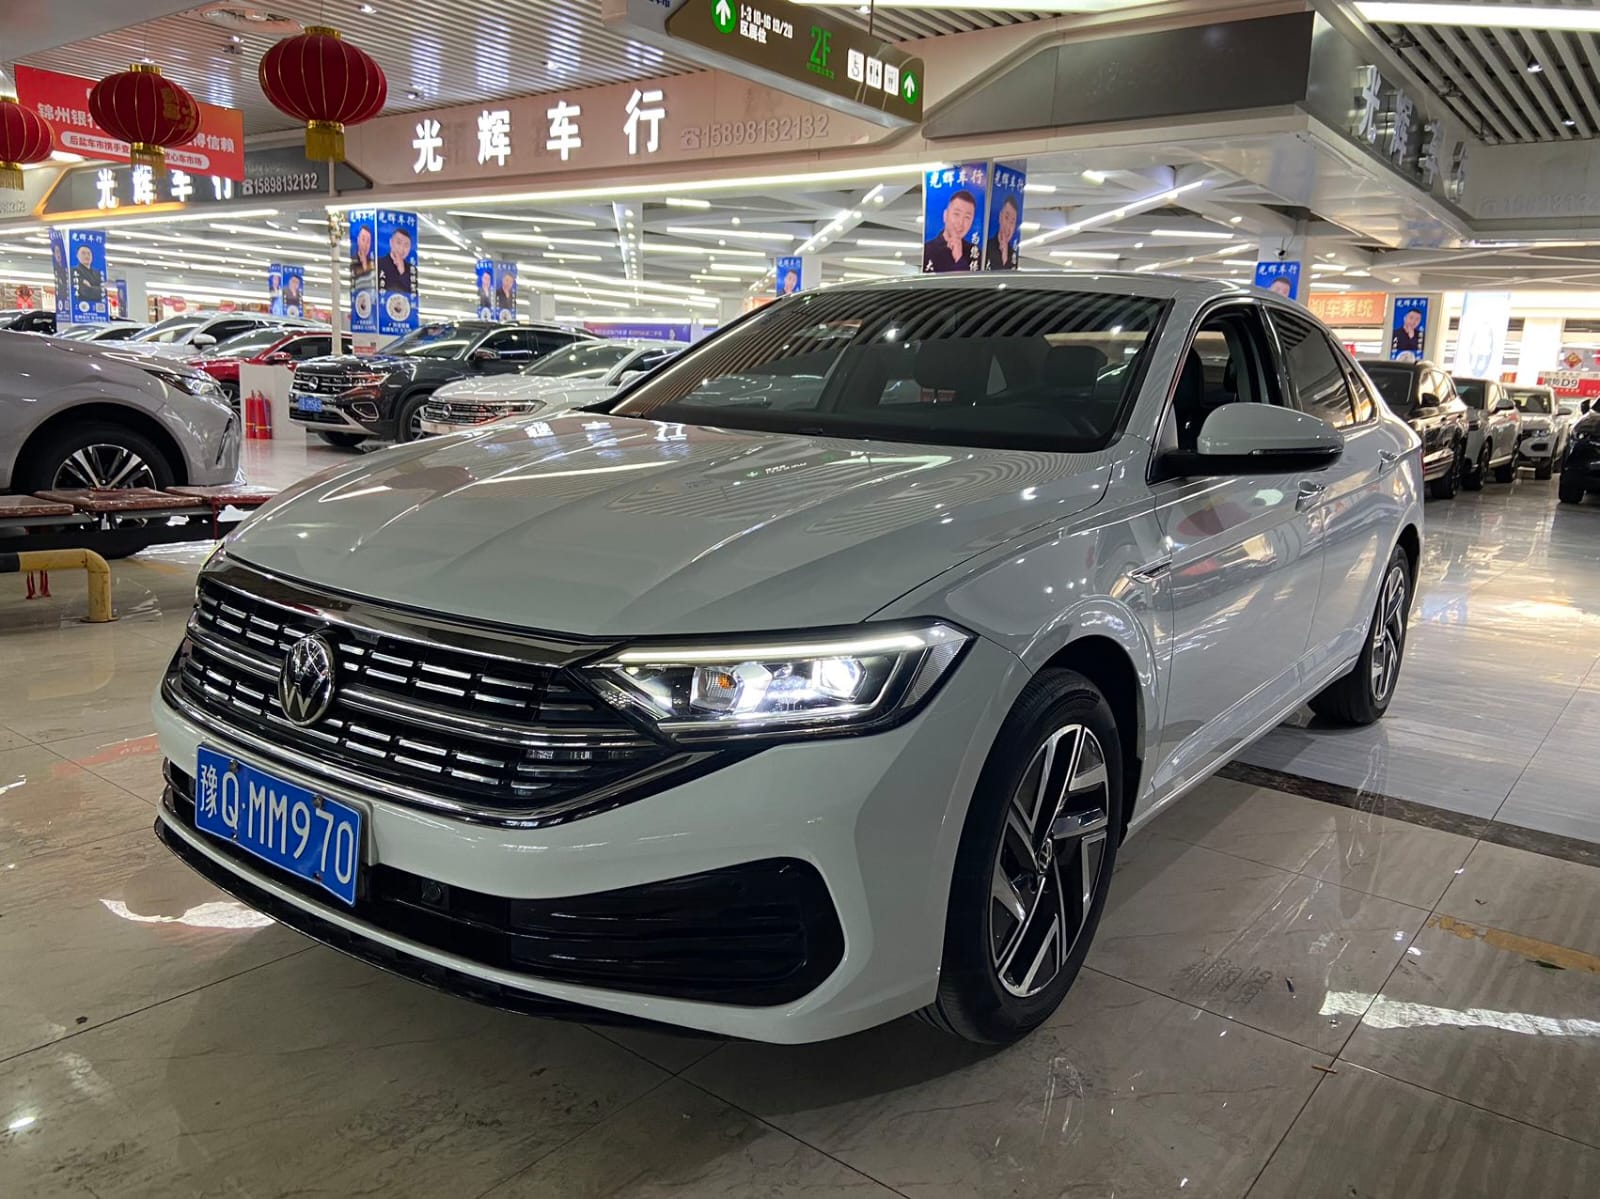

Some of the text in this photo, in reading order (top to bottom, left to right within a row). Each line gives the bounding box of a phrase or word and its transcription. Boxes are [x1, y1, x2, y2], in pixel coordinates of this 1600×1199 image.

[811, 25, 832, 66] 2F
[411, 88, 666, 174] 光辉车行
[702, 114, 830, 148] 15898132132
[254, 172, 318, 195] 15898132132
[929, 169, 984, 189] 光辉车行
[200, 763, 355, 885] 豫Q·MM970
